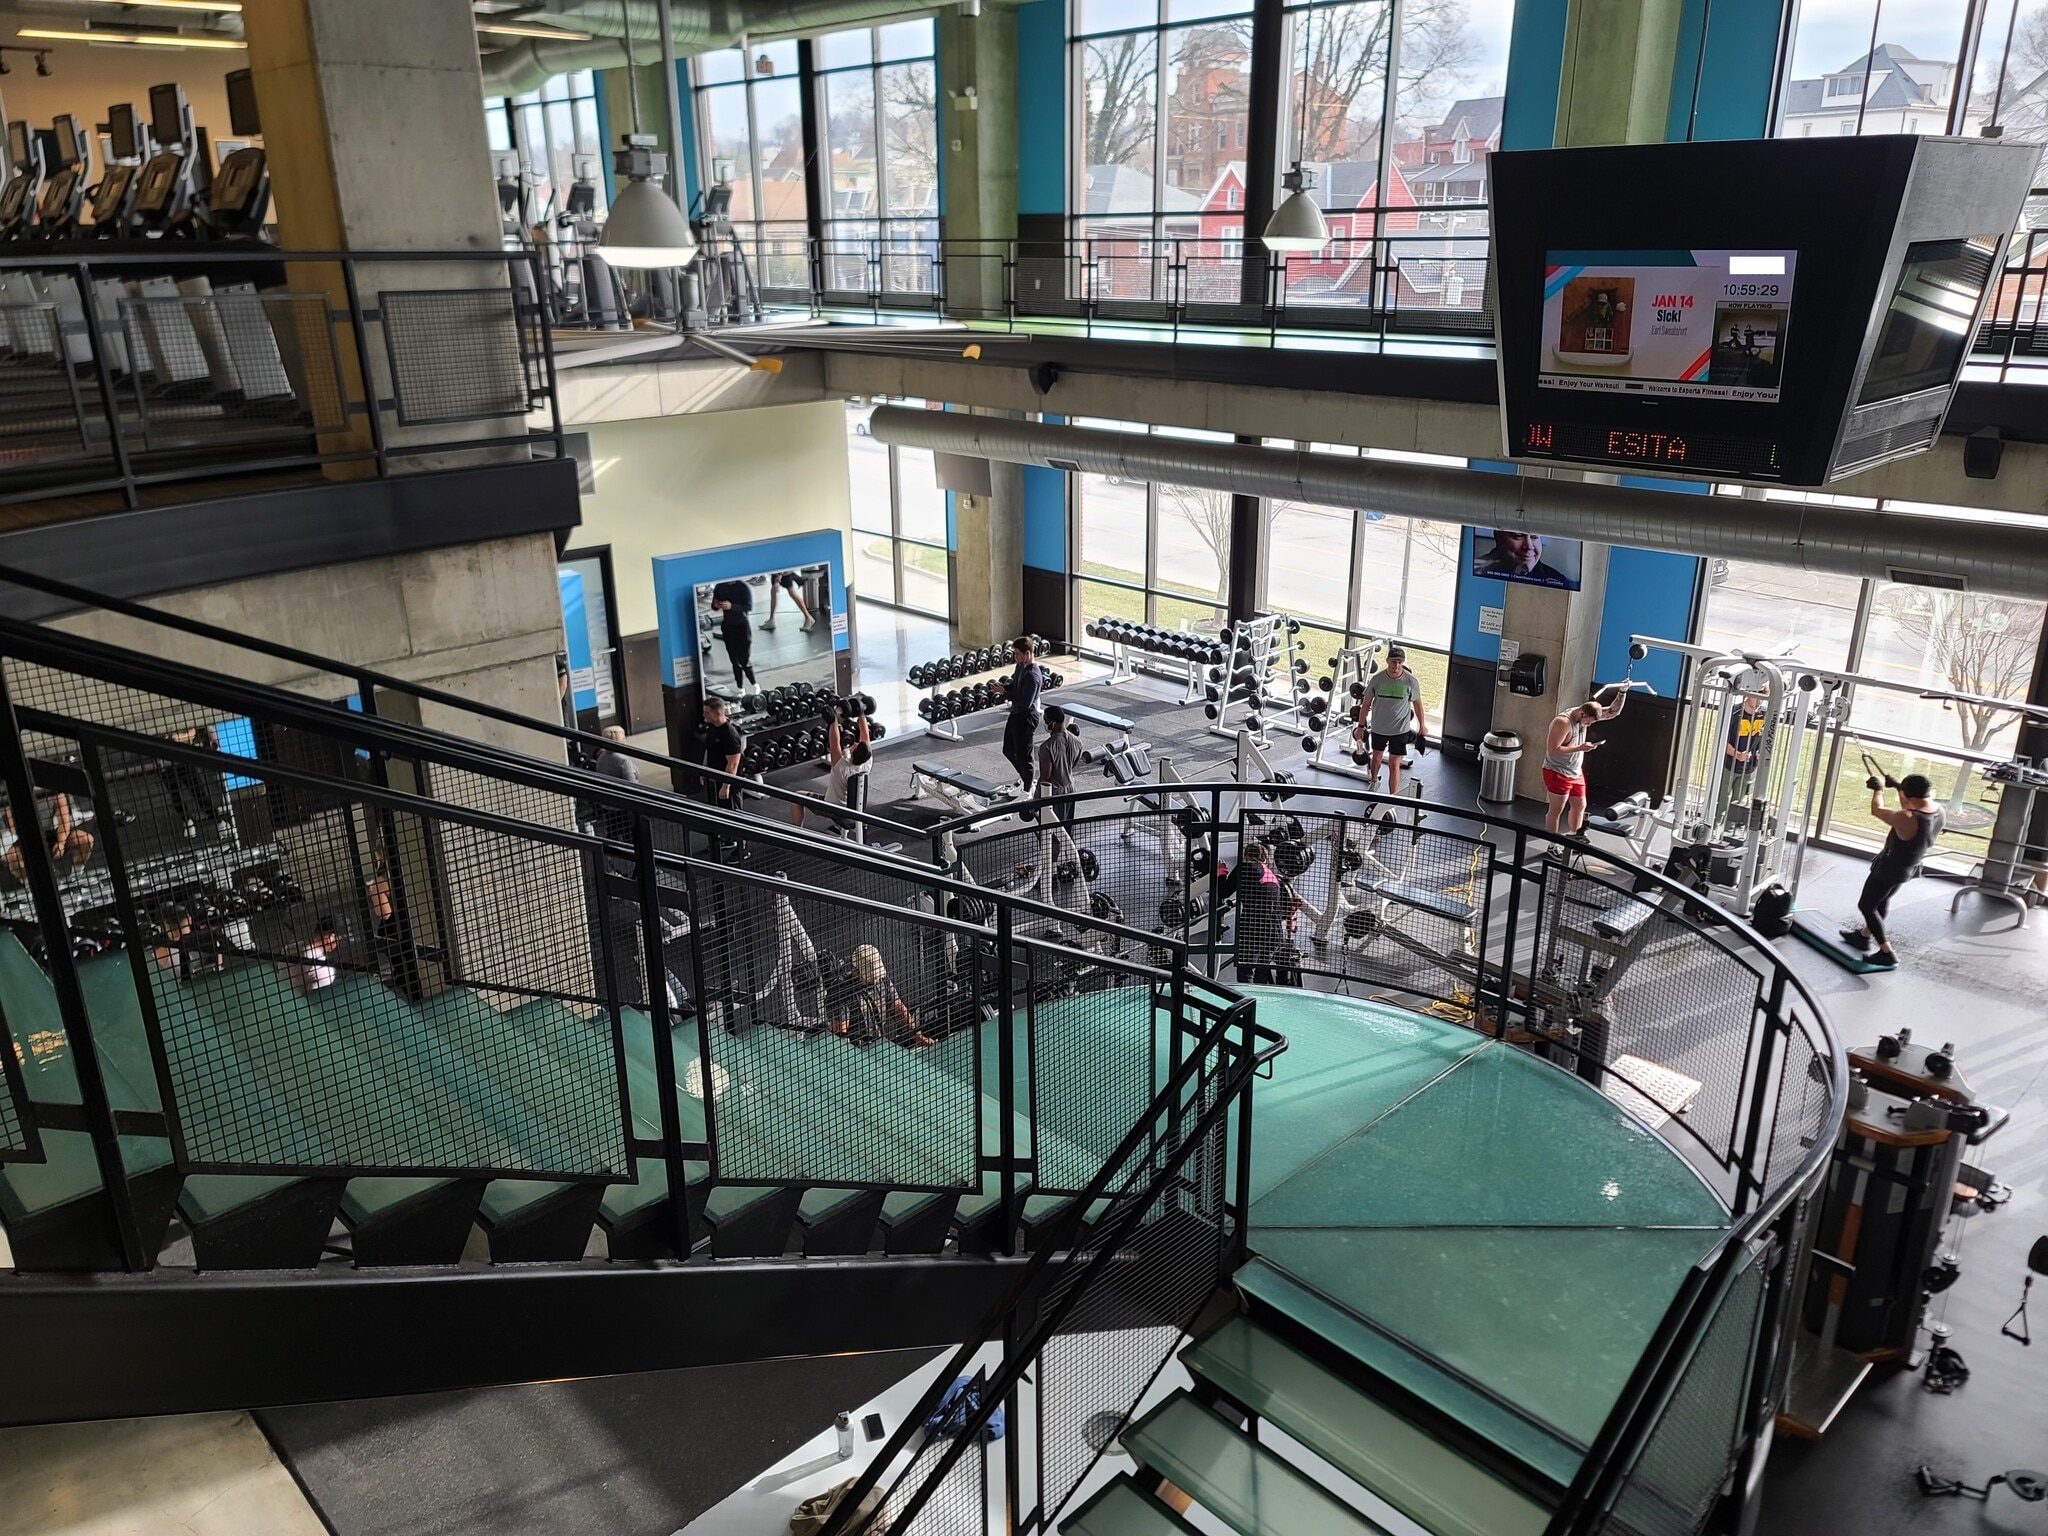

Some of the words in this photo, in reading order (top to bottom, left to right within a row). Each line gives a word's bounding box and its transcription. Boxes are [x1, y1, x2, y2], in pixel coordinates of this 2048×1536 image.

[1723, 284, 1779, 297] 10:59:29
[1651, 295, 1677, 308] JAN
[1680, 295, 1694, 308] 14
[1651, 325, 1662, 336] Earl
[1662, 326, 1688, 336] Sweatshirt
[1558, 379, 1577, 388] Enjoy
[1648, 385, 1671, 393] Welcome
[1678, 386, 1701, 395] Esporta
[1732, 389, 1755, 399] Enjoy
[1756, 391, 1779, 399] Your
[1607, 430, 1687, 461] ESITA
